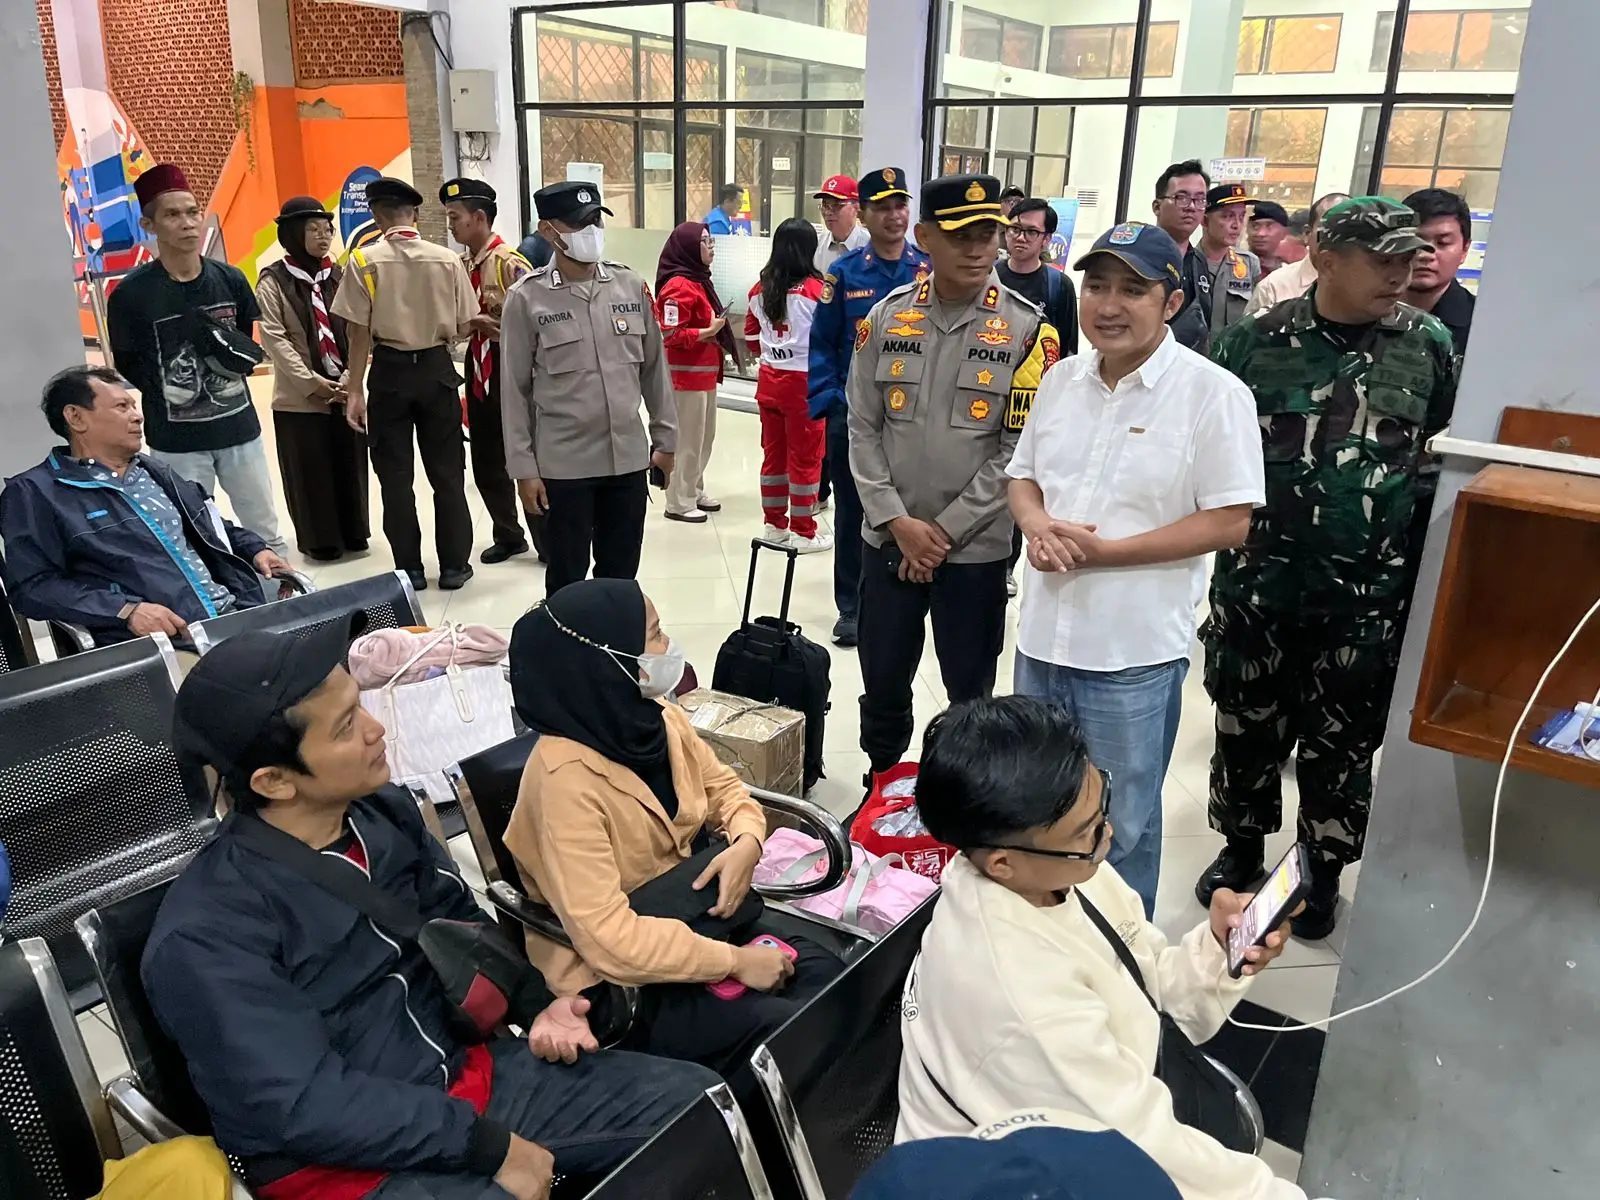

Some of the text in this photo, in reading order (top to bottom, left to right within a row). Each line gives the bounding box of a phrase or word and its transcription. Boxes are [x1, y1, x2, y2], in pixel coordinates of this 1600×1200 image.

[349, 182, 368, 192] Seam
[343, 191, 367, 201] Transp
[611, 303, 641, 313] POLRI
[538, 311, 573, 326] CANDRA
[882, 340, 922, 354] AKMAL
[967, 348, 1012, 364] POLRI
[979, 1113, 1049, 1141] HOND
